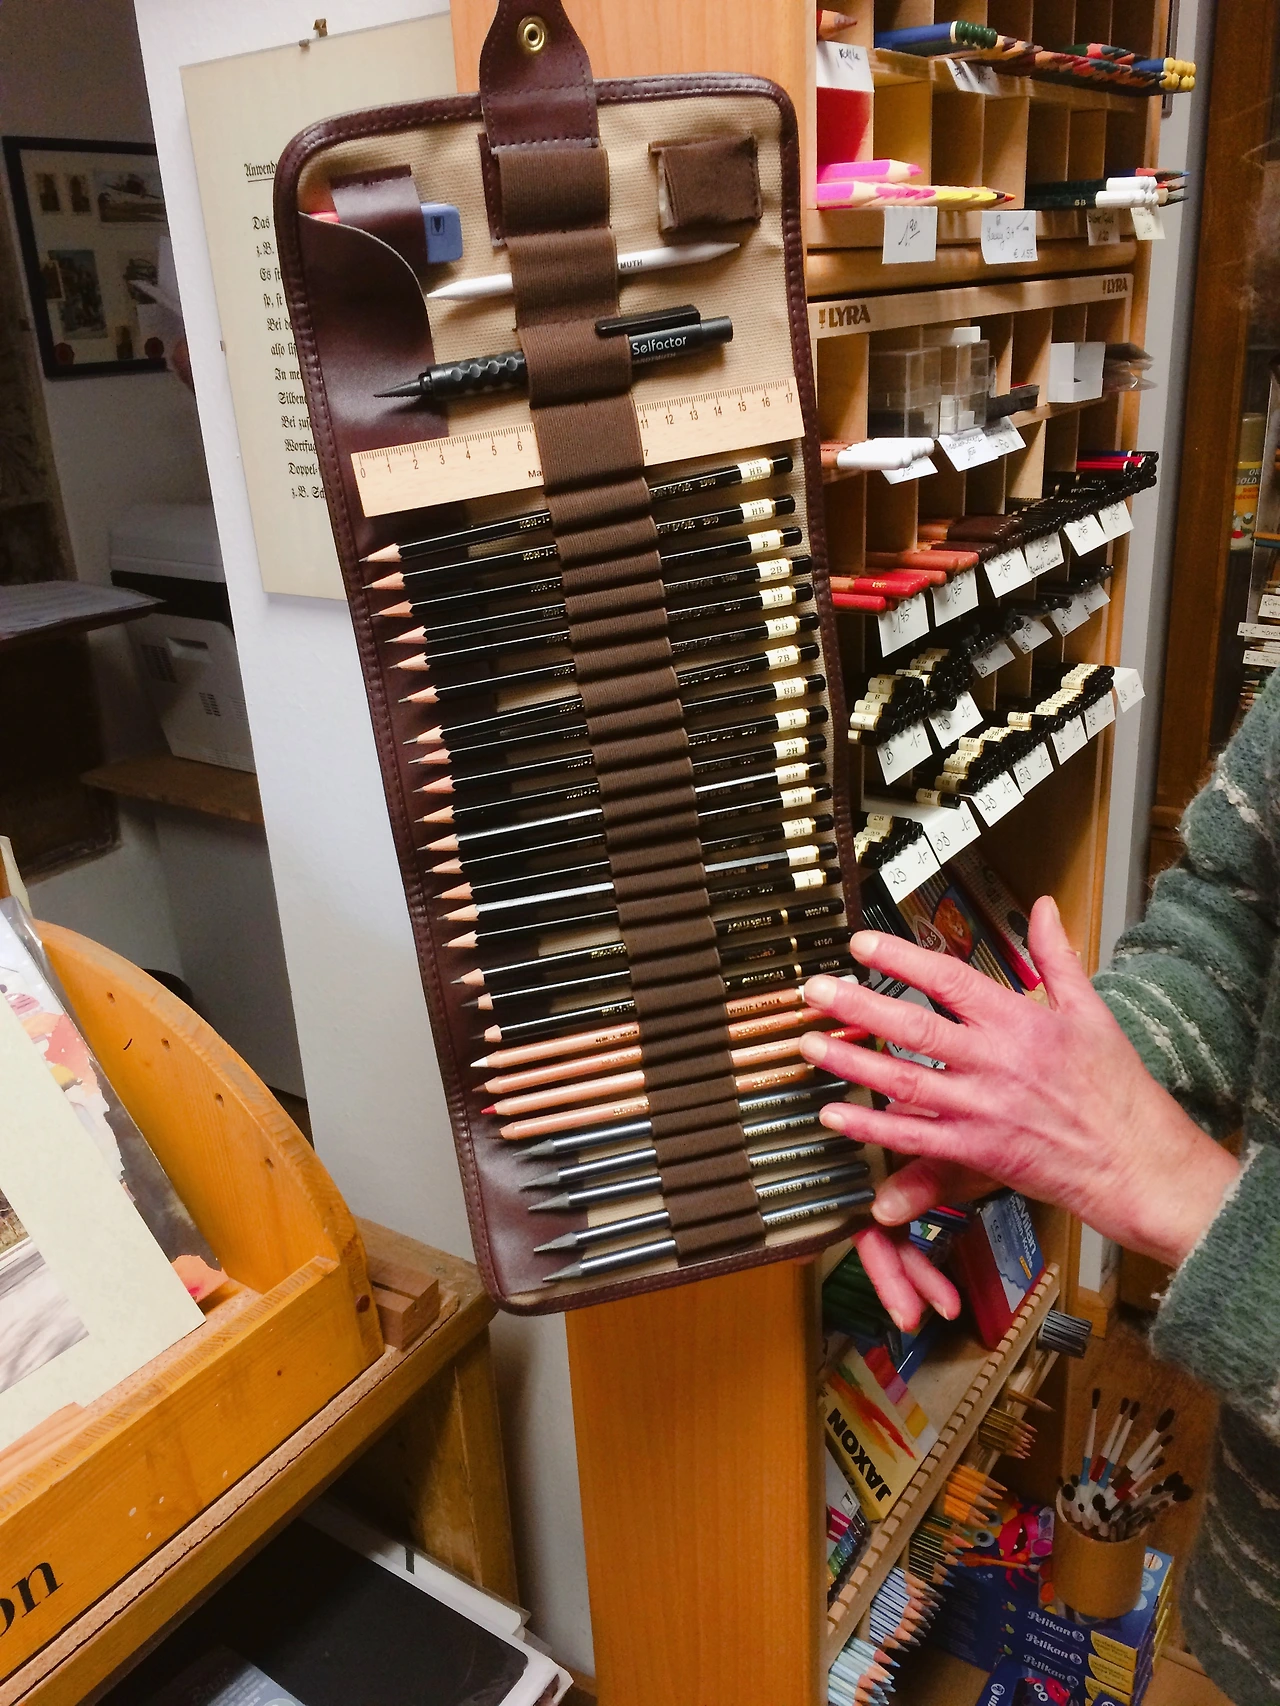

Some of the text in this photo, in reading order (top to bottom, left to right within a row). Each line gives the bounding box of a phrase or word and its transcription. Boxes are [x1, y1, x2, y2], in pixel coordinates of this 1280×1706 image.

[1106, 277, 1128, 294] LYRA
[828, 304, 871, 328] LYRA
[632, 335, 688, 356] Selfactor
[360, 467, 366, 479] 0
[412, 459, 419, 470] 2
[440, 454, 446, 465] 3
[465, 450, 471, 461] 4
[491, 445, 498, 456] 5
[516, 440, 523, 451] 6
[640, 418, 650, 429] 11
[664, 414, 675, 426] 12
[689, 410, 699, 421] 13
[713, 405, 723, 417] 14
[737, 401, 747, 413] 15
[761, 396, 771, 408] 16
[785, 392, 794, 403] 17
[749, 466, 763, 477] HB
[751, 506, 765, 516] HB
[762, 540, 769, 549] B
[769, 565, 783, 576] 2B
[775, 622, 789, 632] 6B
[778, 654, 790, 663] 7B
[786, 747, 798, 756] 2H
[759, 1183, 803, 1199] PROGRESSO
[826, 1406, 893, 1503] JAXON
[1027, 1609, 1071, 1637] Pelikan
[1025, 1631, 1069, 1659] Pelikan
[1022, 1653, 1066, 1681] Pelikan
